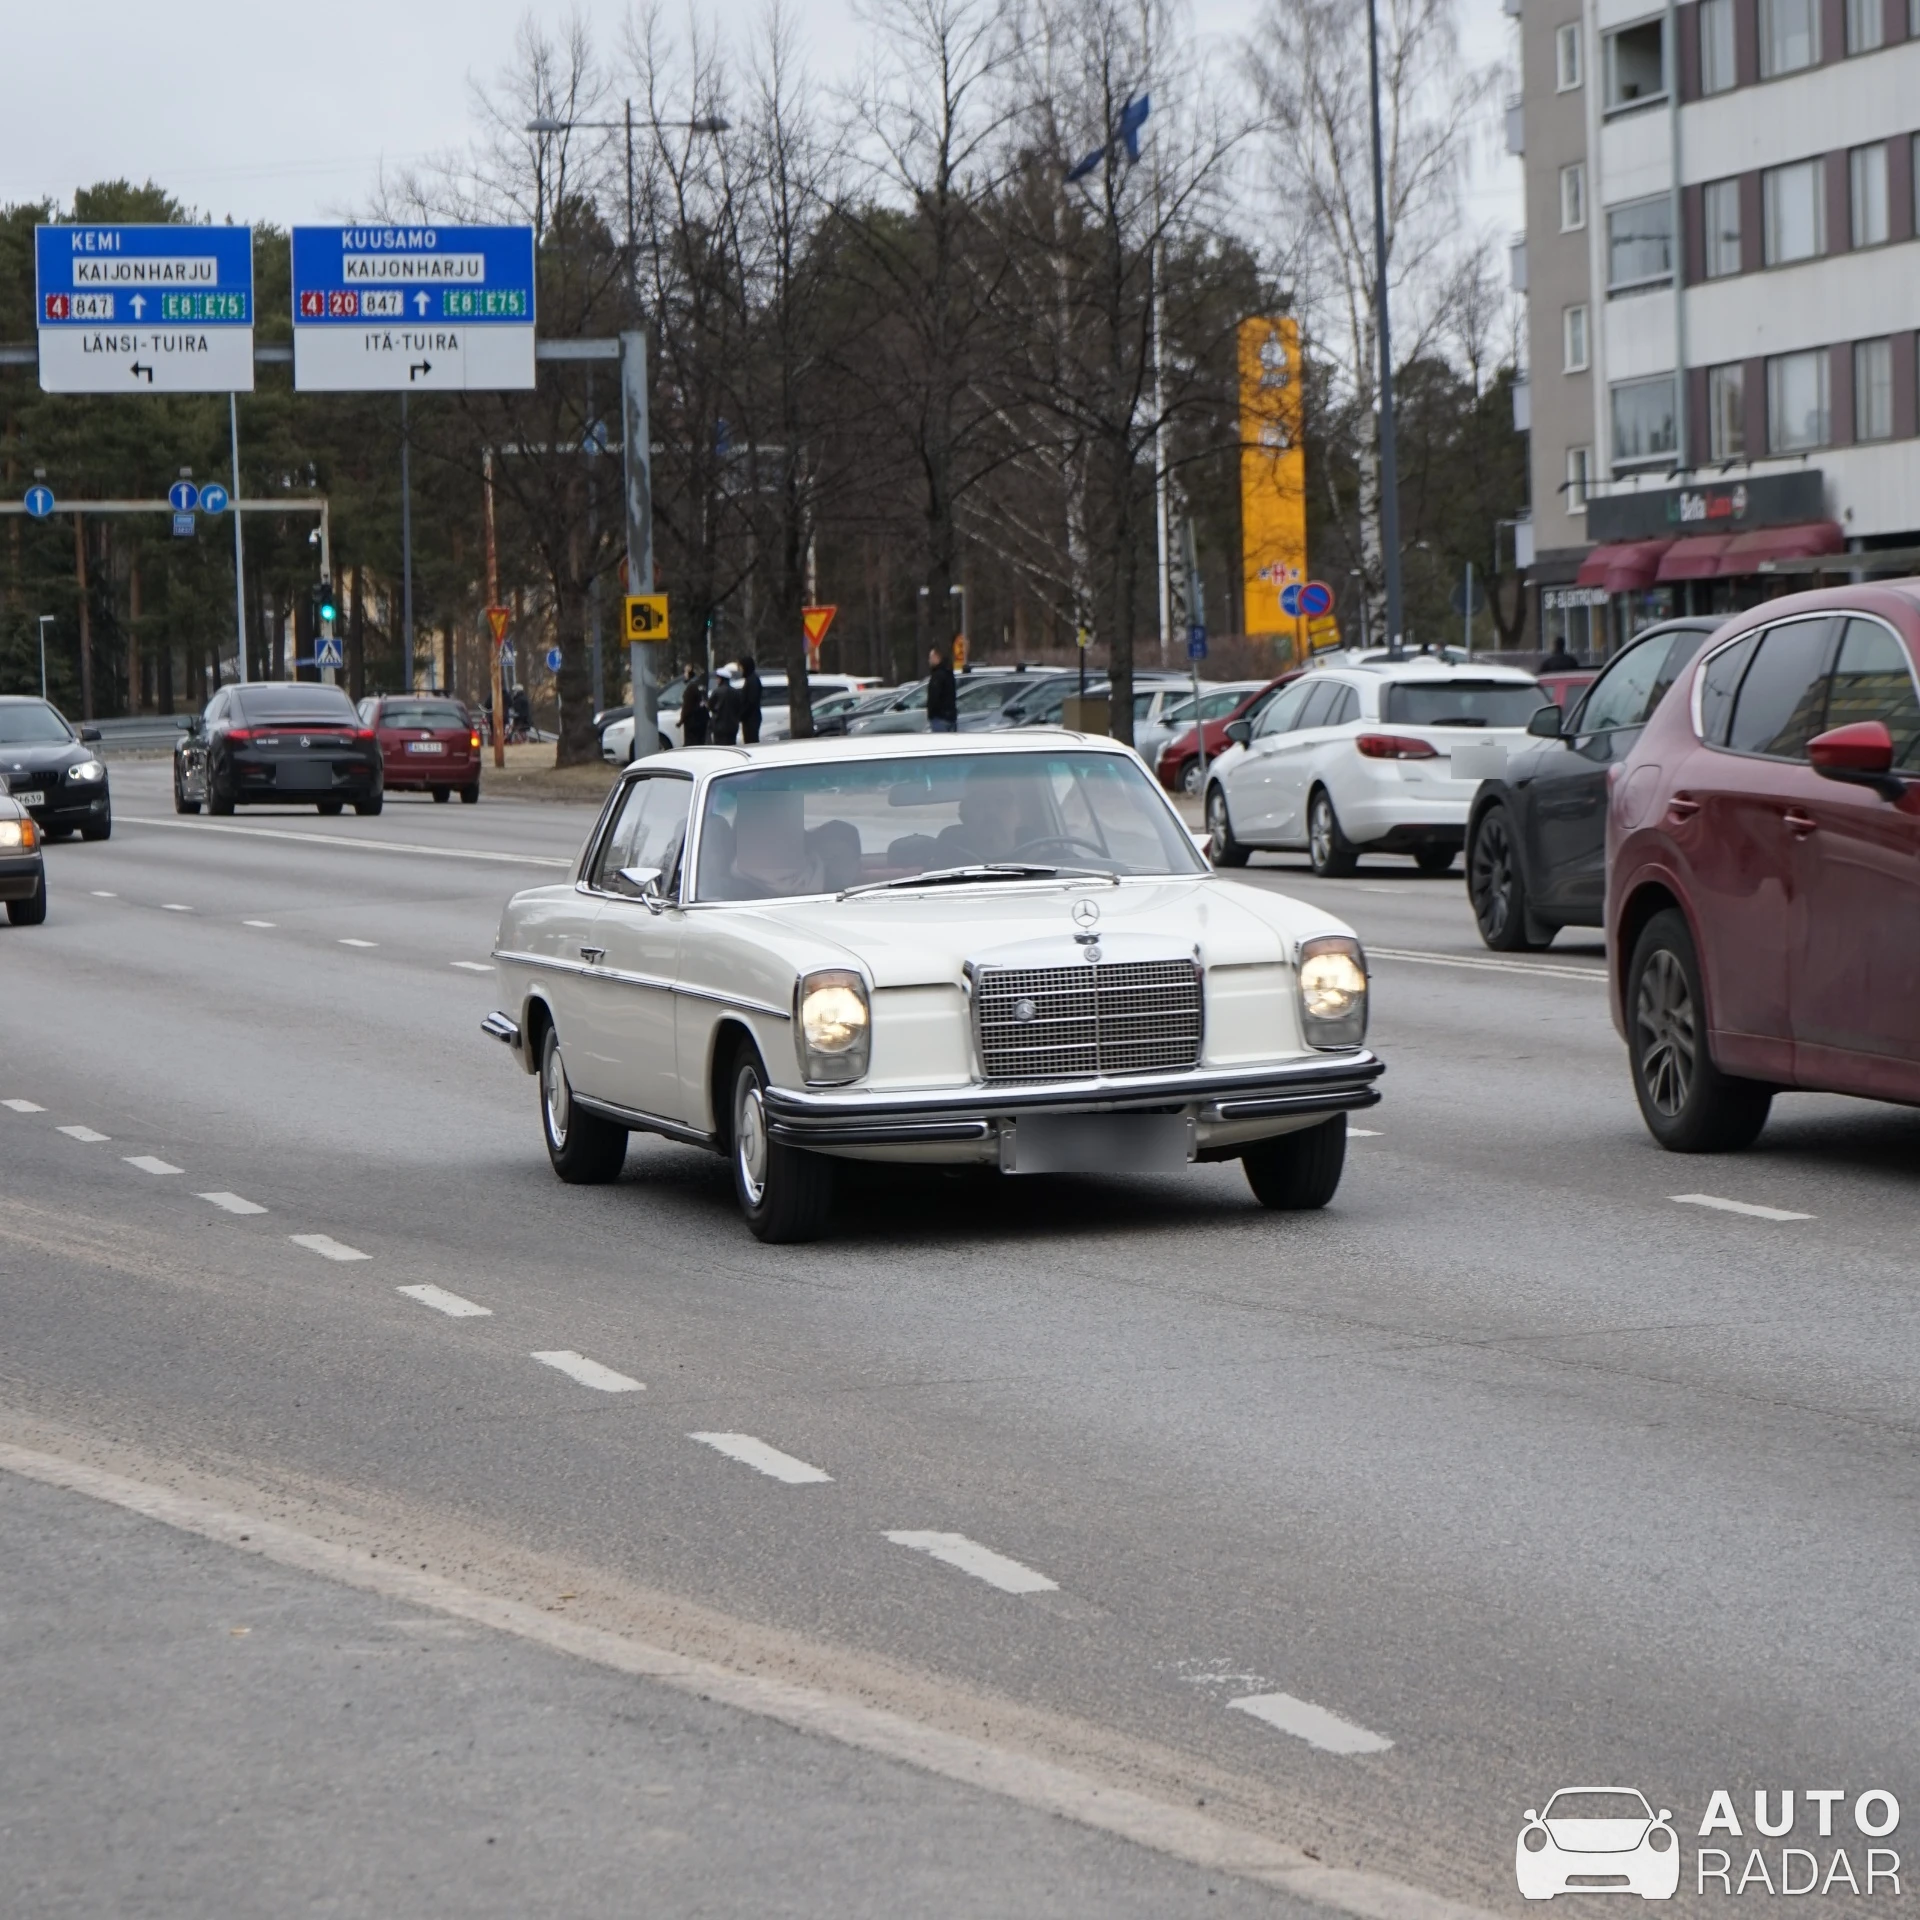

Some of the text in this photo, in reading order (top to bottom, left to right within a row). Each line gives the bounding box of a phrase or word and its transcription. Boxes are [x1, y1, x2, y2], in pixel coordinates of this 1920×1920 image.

[72, 232, 120, 251] KEMI
[342, 230, 437, 249] KUUSAMO
[78, 262, 212, 281] KAIJONHARJU
[346, 260, 479, 278] KAIJONHARJU
[51, 298, 239, 316] 4 847 E8 E75
[306, 294, 519, 313] 4 20 847 E8 E75
[83, 332, 209, 353] LÄNSI-TUIRA
[365, 331, 459, 351] ITÄ-TUIRA
